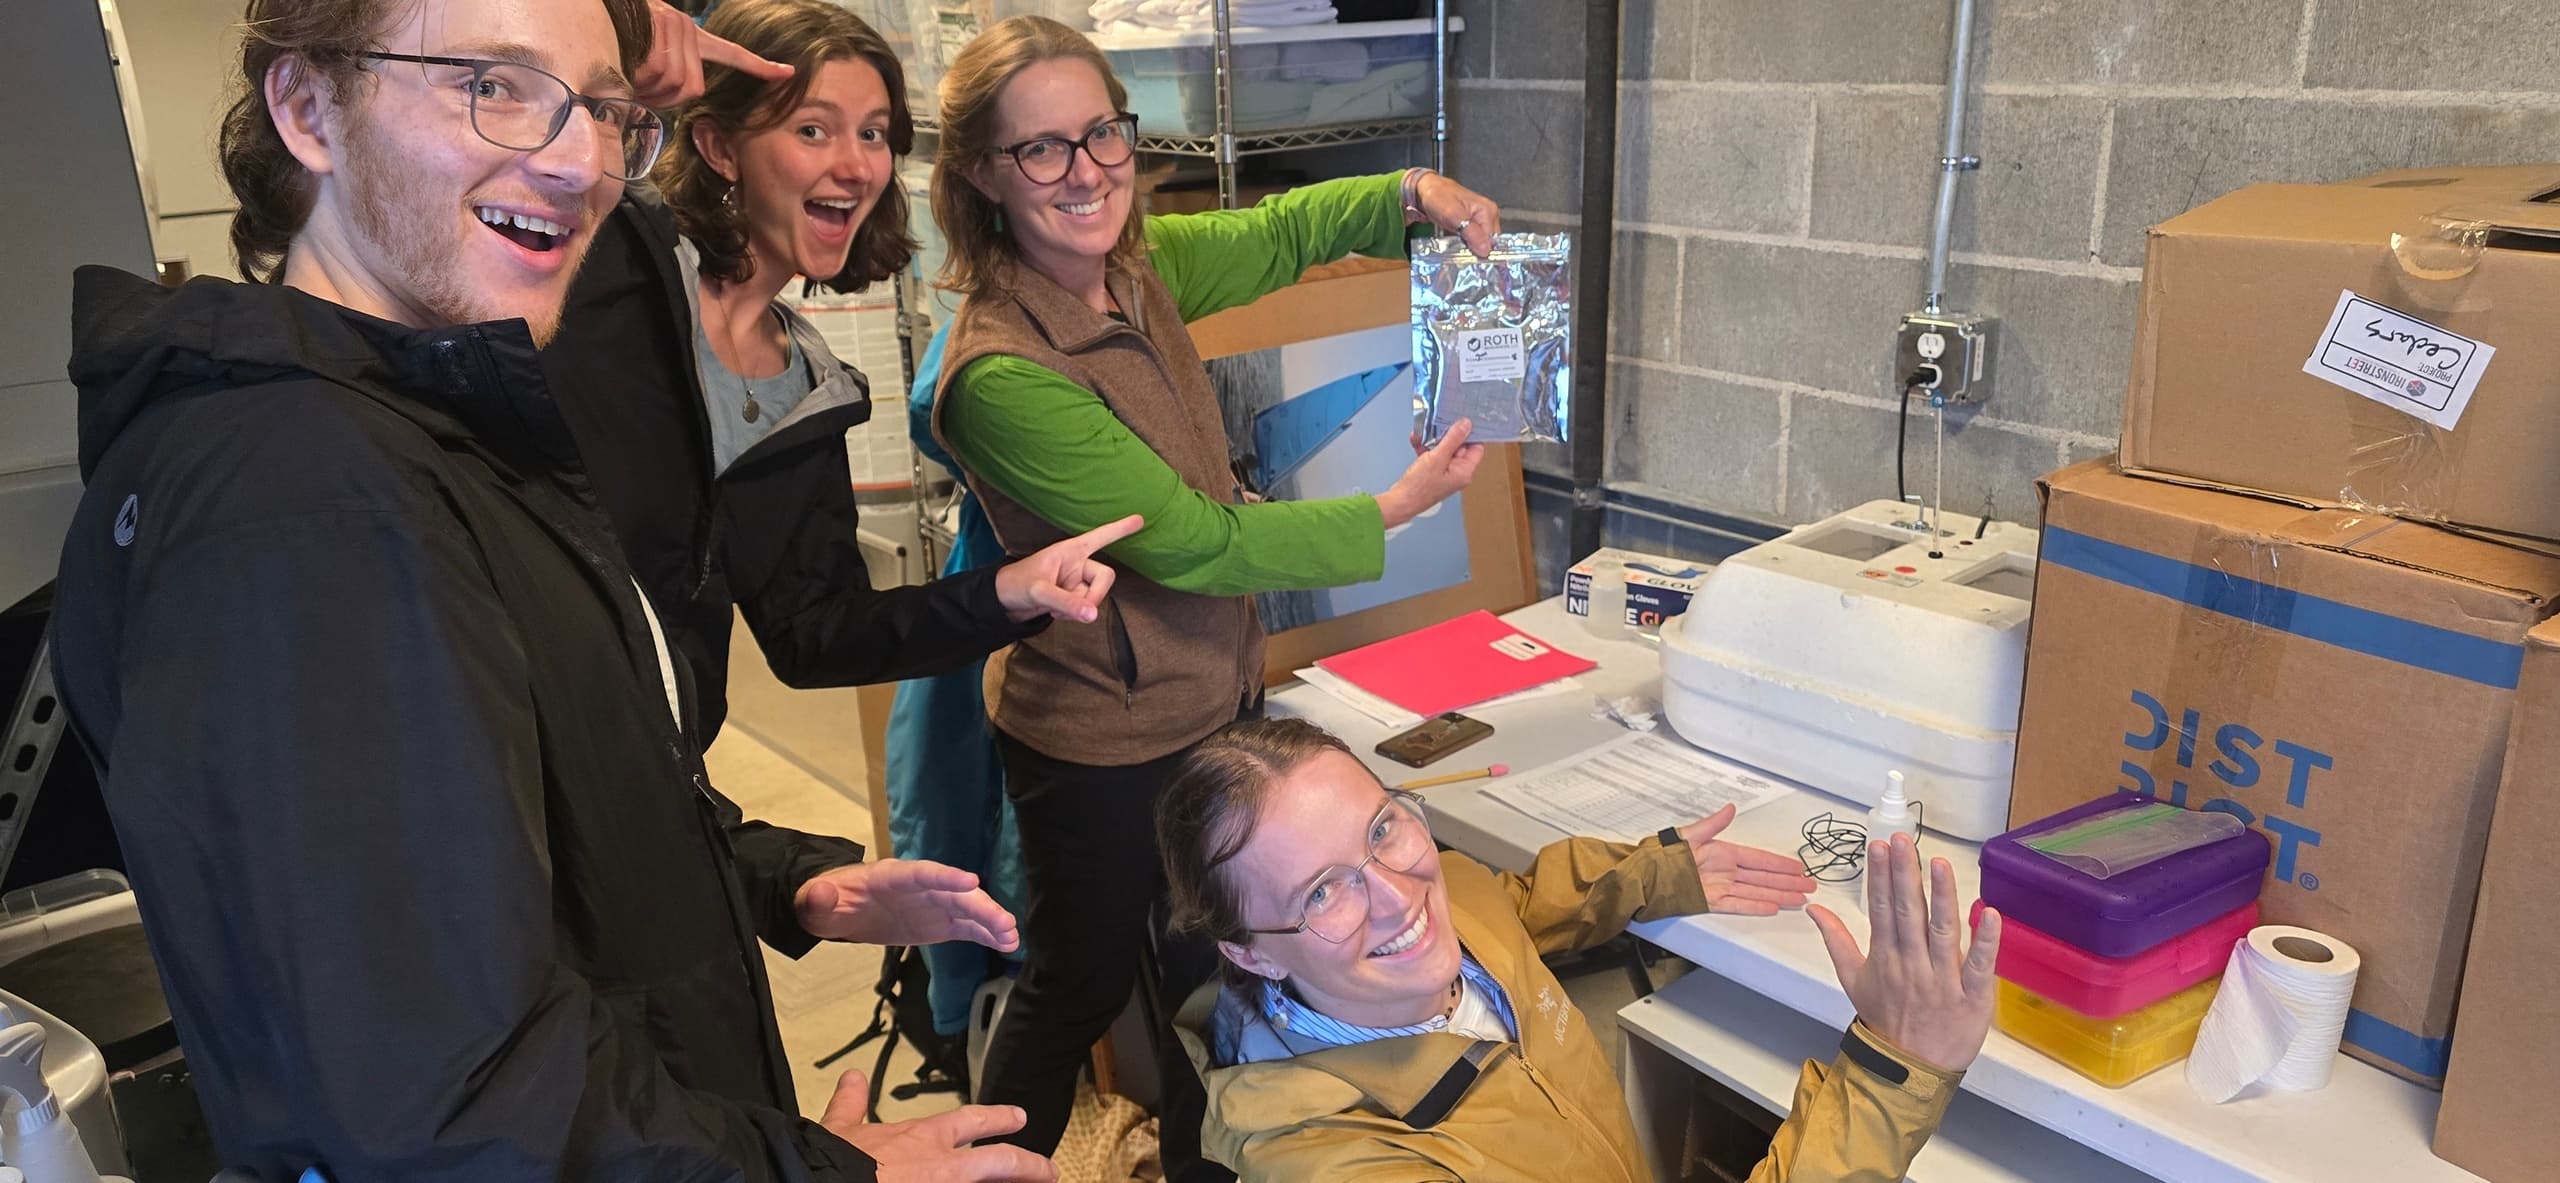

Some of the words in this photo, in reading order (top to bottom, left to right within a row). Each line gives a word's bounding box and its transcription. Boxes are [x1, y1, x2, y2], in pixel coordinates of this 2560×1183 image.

[1484, 334, 1518, 345] ROTH
[2365, 318, 2462, 370] Cedars
[2344, 355, 2407, 390] IRONSTREET
[1647, 578, 1699, 591] GLOV
[2124, 689, 2334, 809] DIST
